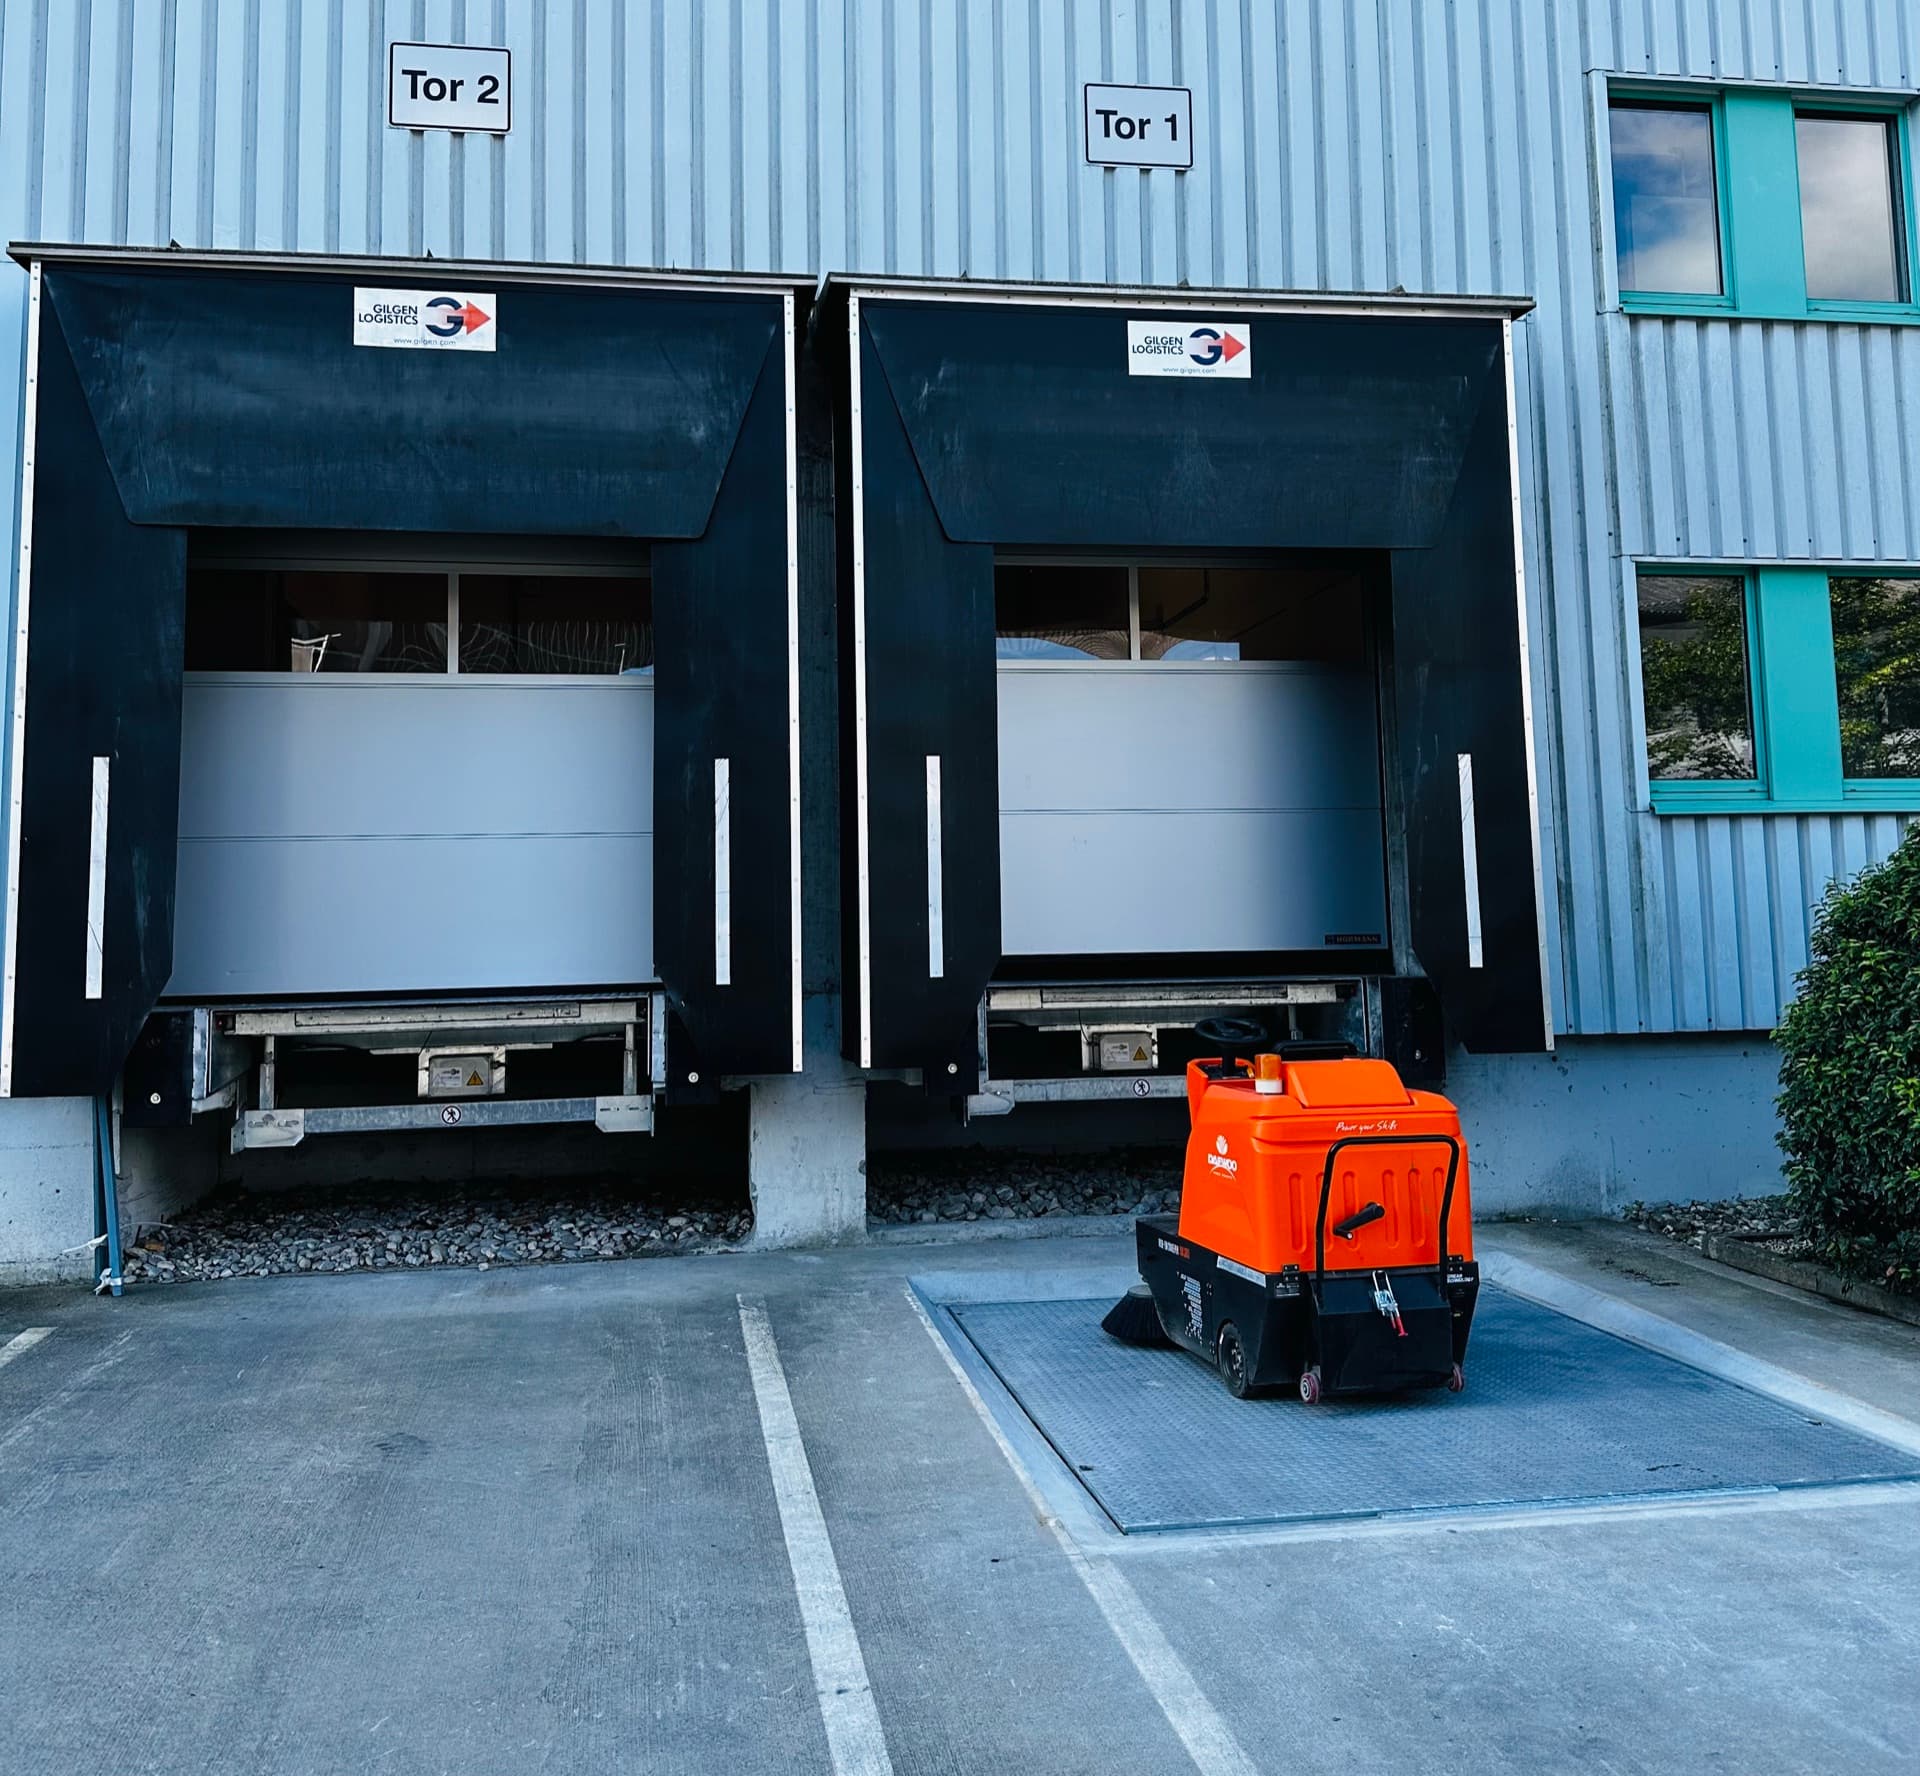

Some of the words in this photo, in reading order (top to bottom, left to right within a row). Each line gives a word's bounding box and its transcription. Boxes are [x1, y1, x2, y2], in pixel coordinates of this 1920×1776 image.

[401, 69, 465, 102] Tor
[477, 74, 500, 104] 2
[1095, 109, 1151, 140] Tor
[1164, 113, 1177, 142] 1
[372, 303, 418, 315] GILGEN
[358, 312, 418, 326] LOGISTICS
[393, 336, 457, 346] www.gilgen.com
[1144, 335, 1183, 346] GILGEN
[1131, 344, 1184, 355] LOGISTICS
[1162, 366, 1217, 375] www.gilgen.com
[1208, 1153, 1237, 1171] DAEWOO
